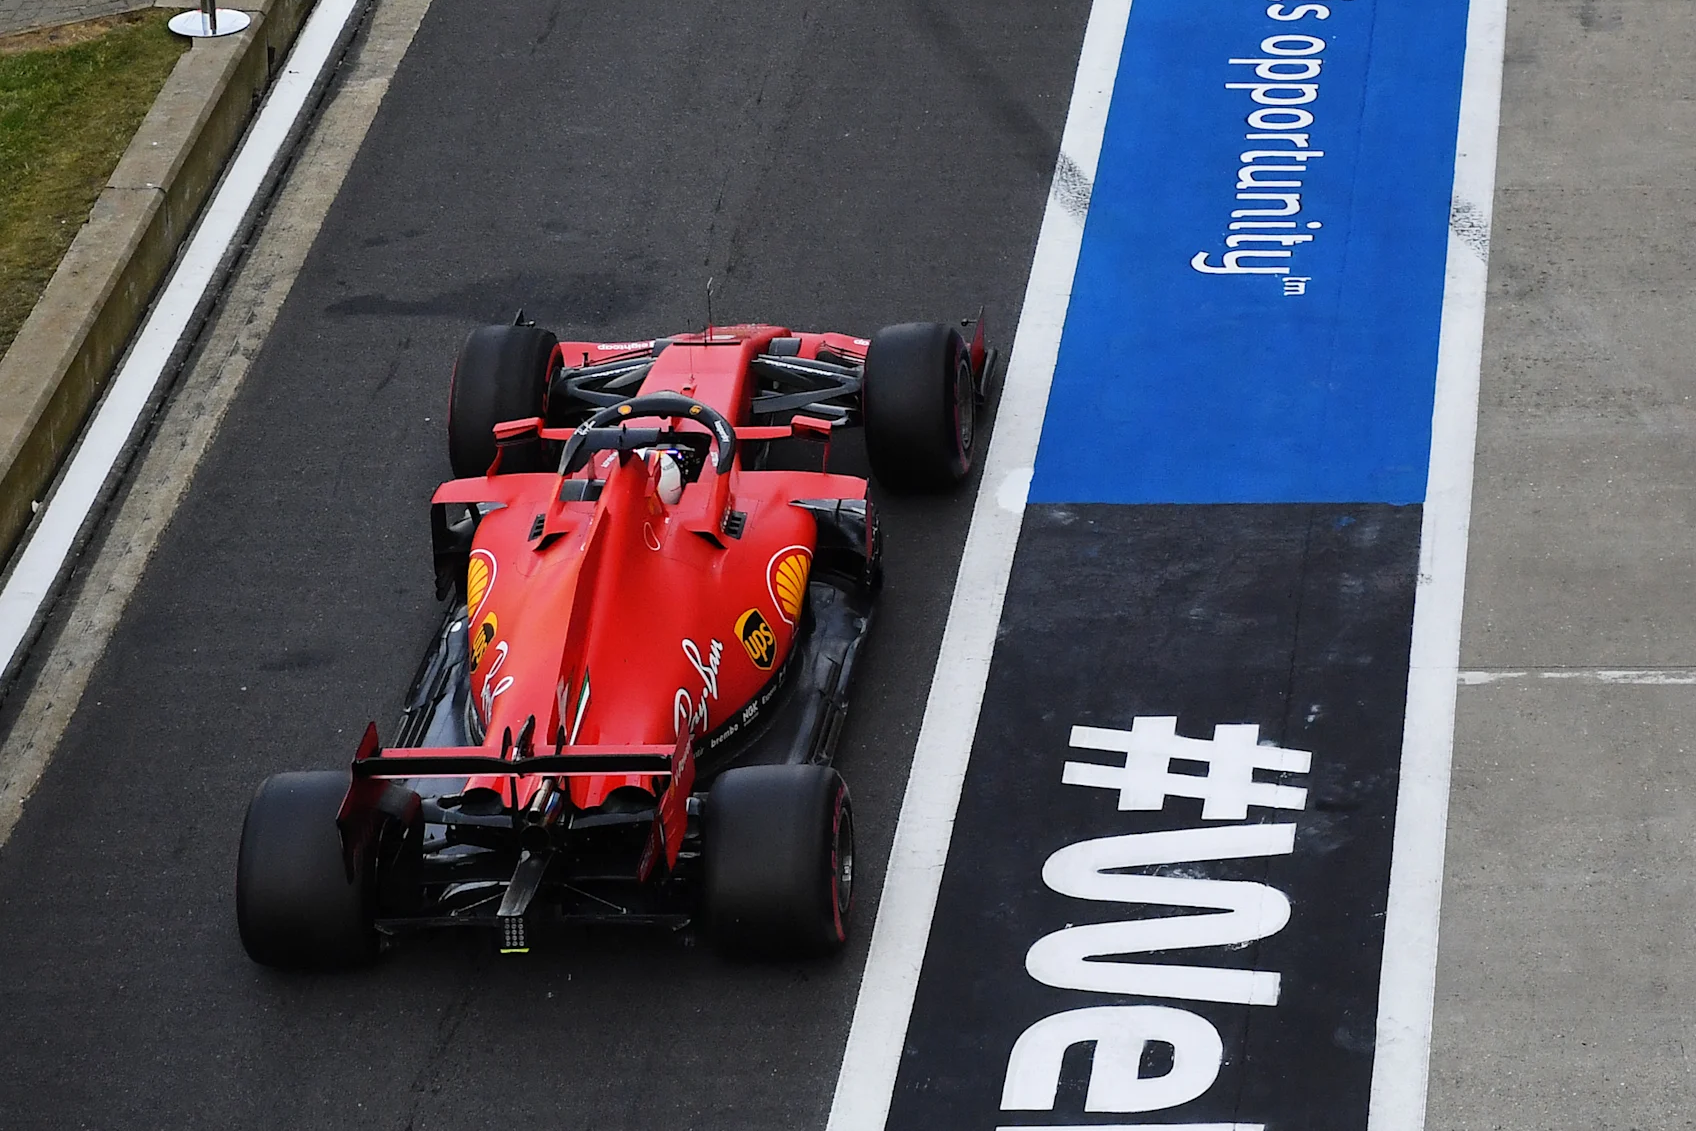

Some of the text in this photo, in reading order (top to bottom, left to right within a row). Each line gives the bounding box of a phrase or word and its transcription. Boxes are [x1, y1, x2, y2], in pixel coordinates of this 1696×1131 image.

[1190, 34, 1326, 275] opportunity
[744, 622, 774, 663] ups
[710, 701, 759, 749] brembo NGK
[995, 716, 1312, 1131] #We
